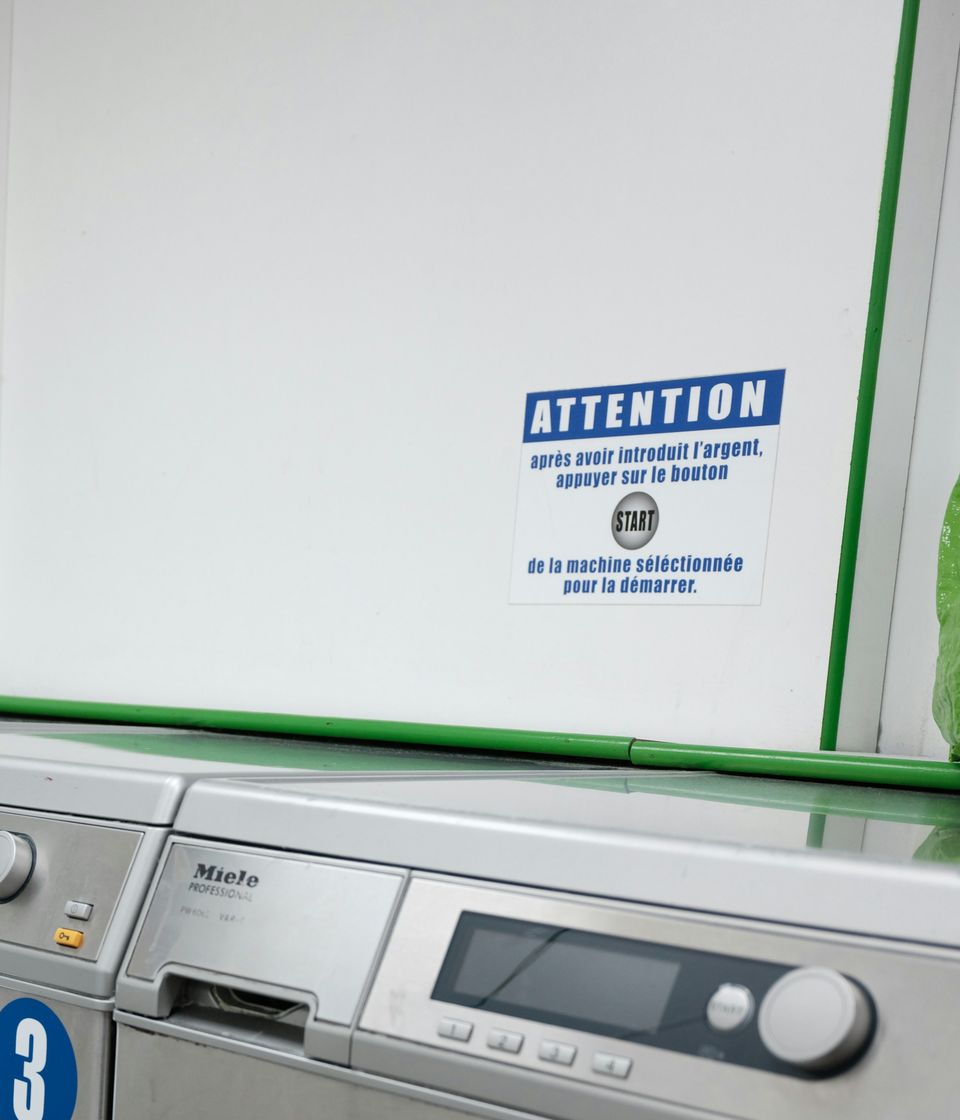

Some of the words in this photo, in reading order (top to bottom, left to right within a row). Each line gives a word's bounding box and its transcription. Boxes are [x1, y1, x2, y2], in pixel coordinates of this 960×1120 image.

[529, 379, 767, 435] ATTENTION
[530, 450, 571, 471] après
[575, 447, 614, 466] avoir
[618, 443, 689, 464] introduit
[693, 438, 763, 461] l'argent,
[556, 469, 617, 490] appuyer
[621, 468, 647, 485] sur
[651, 466, 666, 484] le
[671, 463, 728, 482] bouton
[615, 509, 655, 532] START
[528, 558, 545, 574] de
[549, 558, 562, 574] la
[567, 556, 631, 574] machine
[636, 553, 744, 573] séléctionnée
[563, 578, 597, 595] pour
[601, 577, 615, 593] la
[620, 576, 697, 594] démarrer.
[193, 863, 259, 888] Miele
